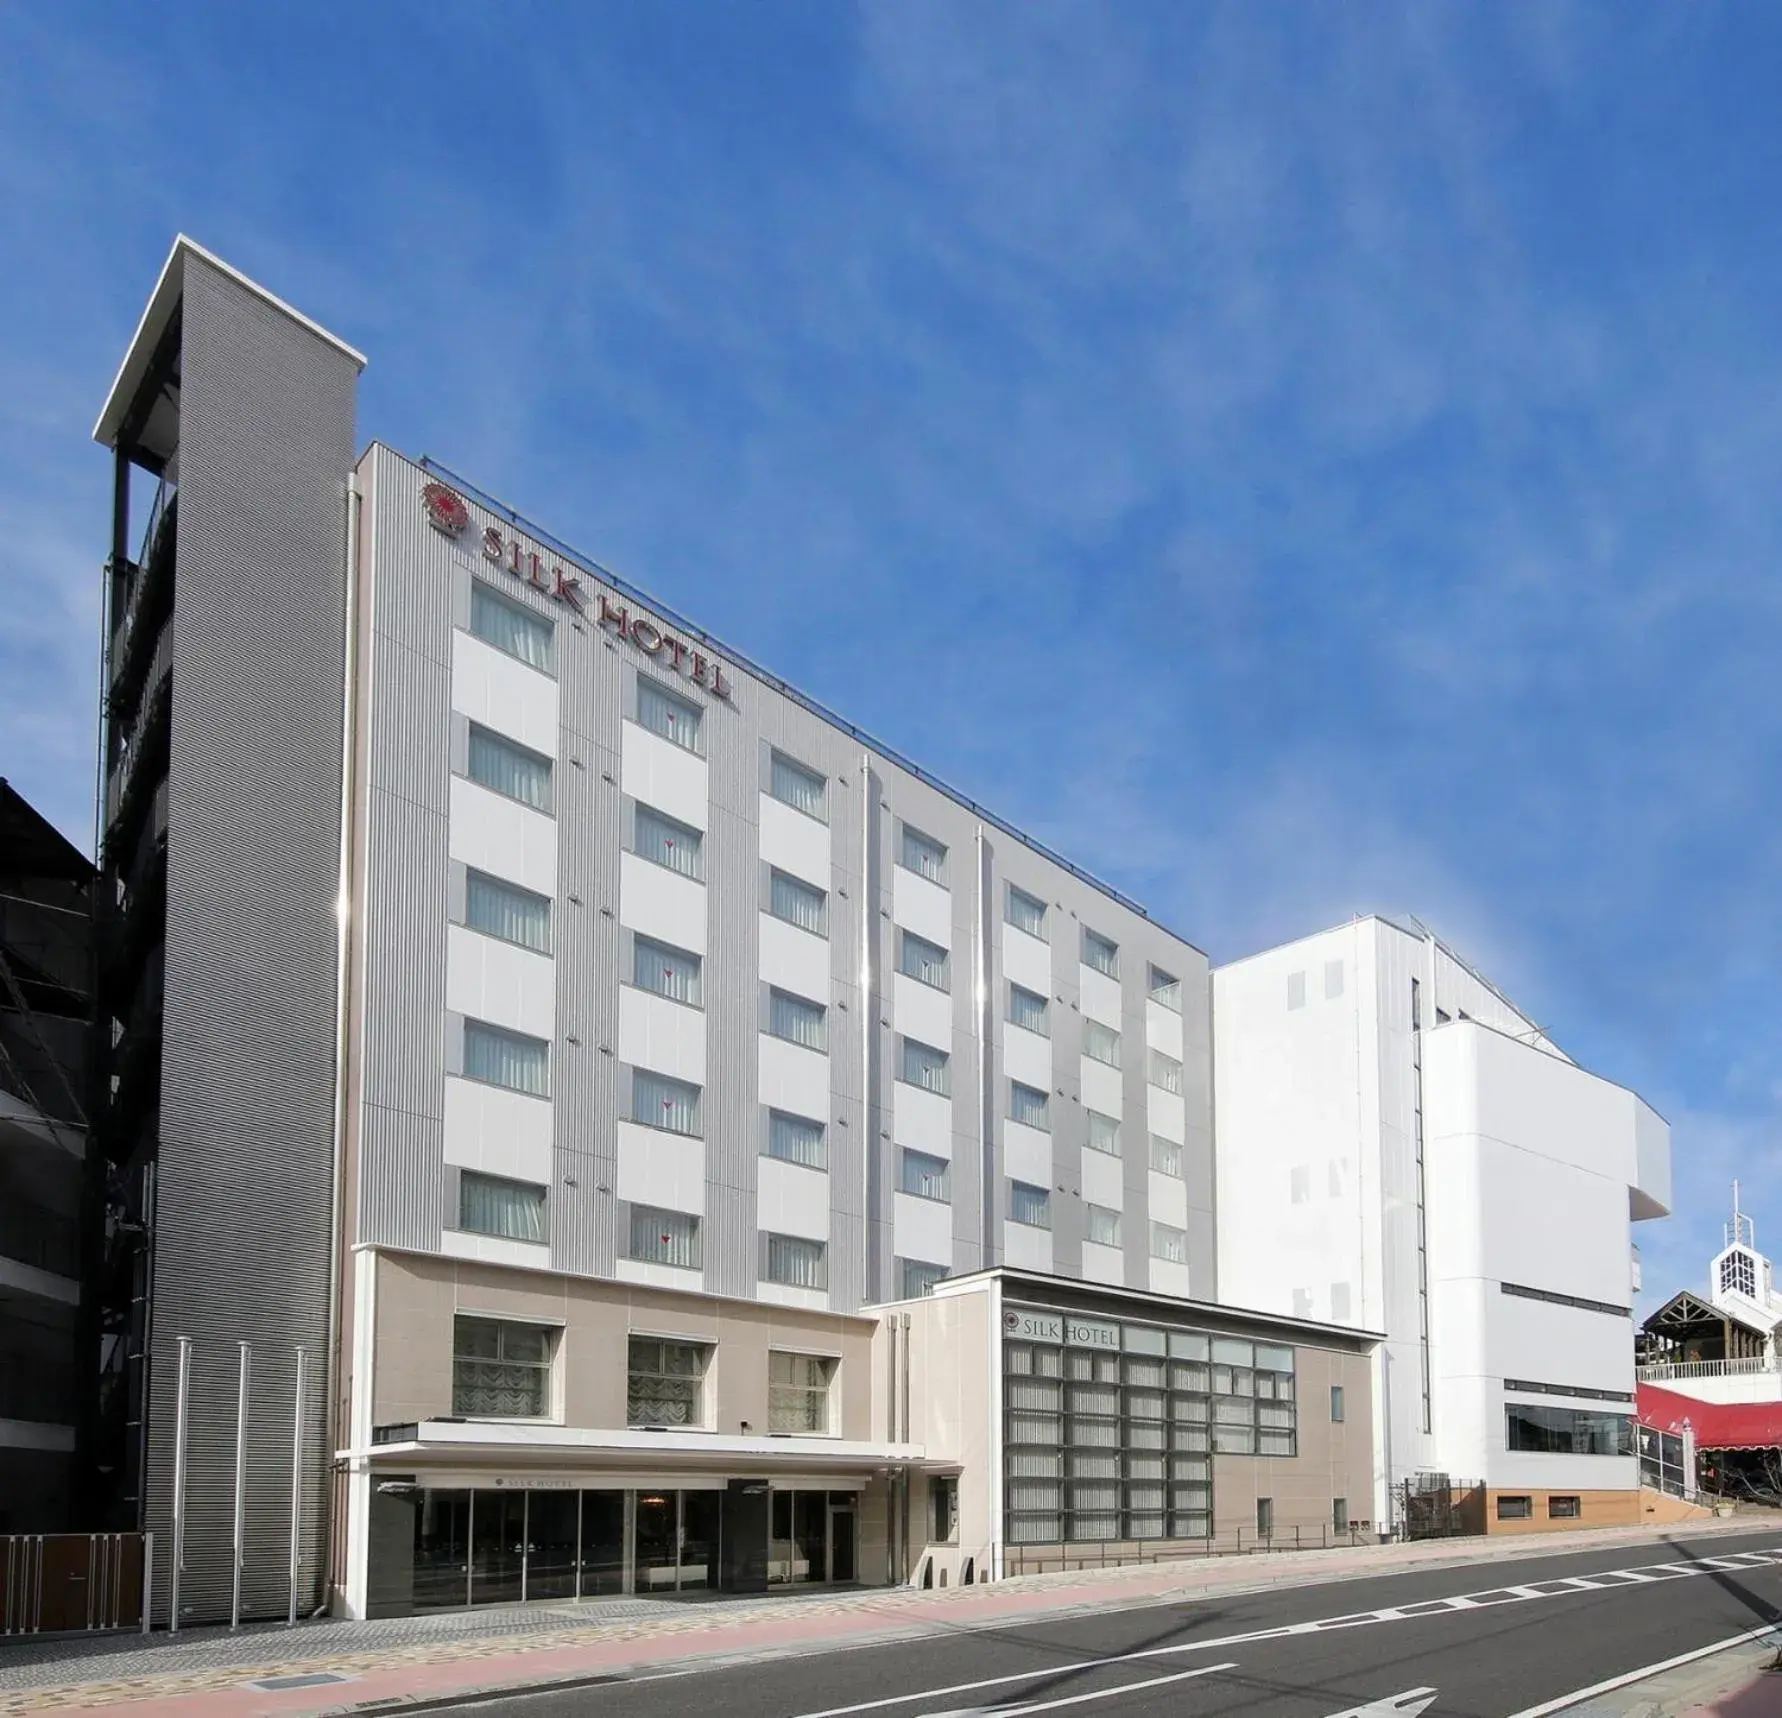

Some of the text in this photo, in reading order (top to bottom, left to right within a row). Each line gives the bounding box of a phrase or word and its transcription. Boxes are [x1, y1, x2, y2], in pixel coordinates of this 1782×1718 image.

[482, 527, 732, 698] SILK HOTEL
[1024, 1319, 1116, 1346] SILK HOTEL
